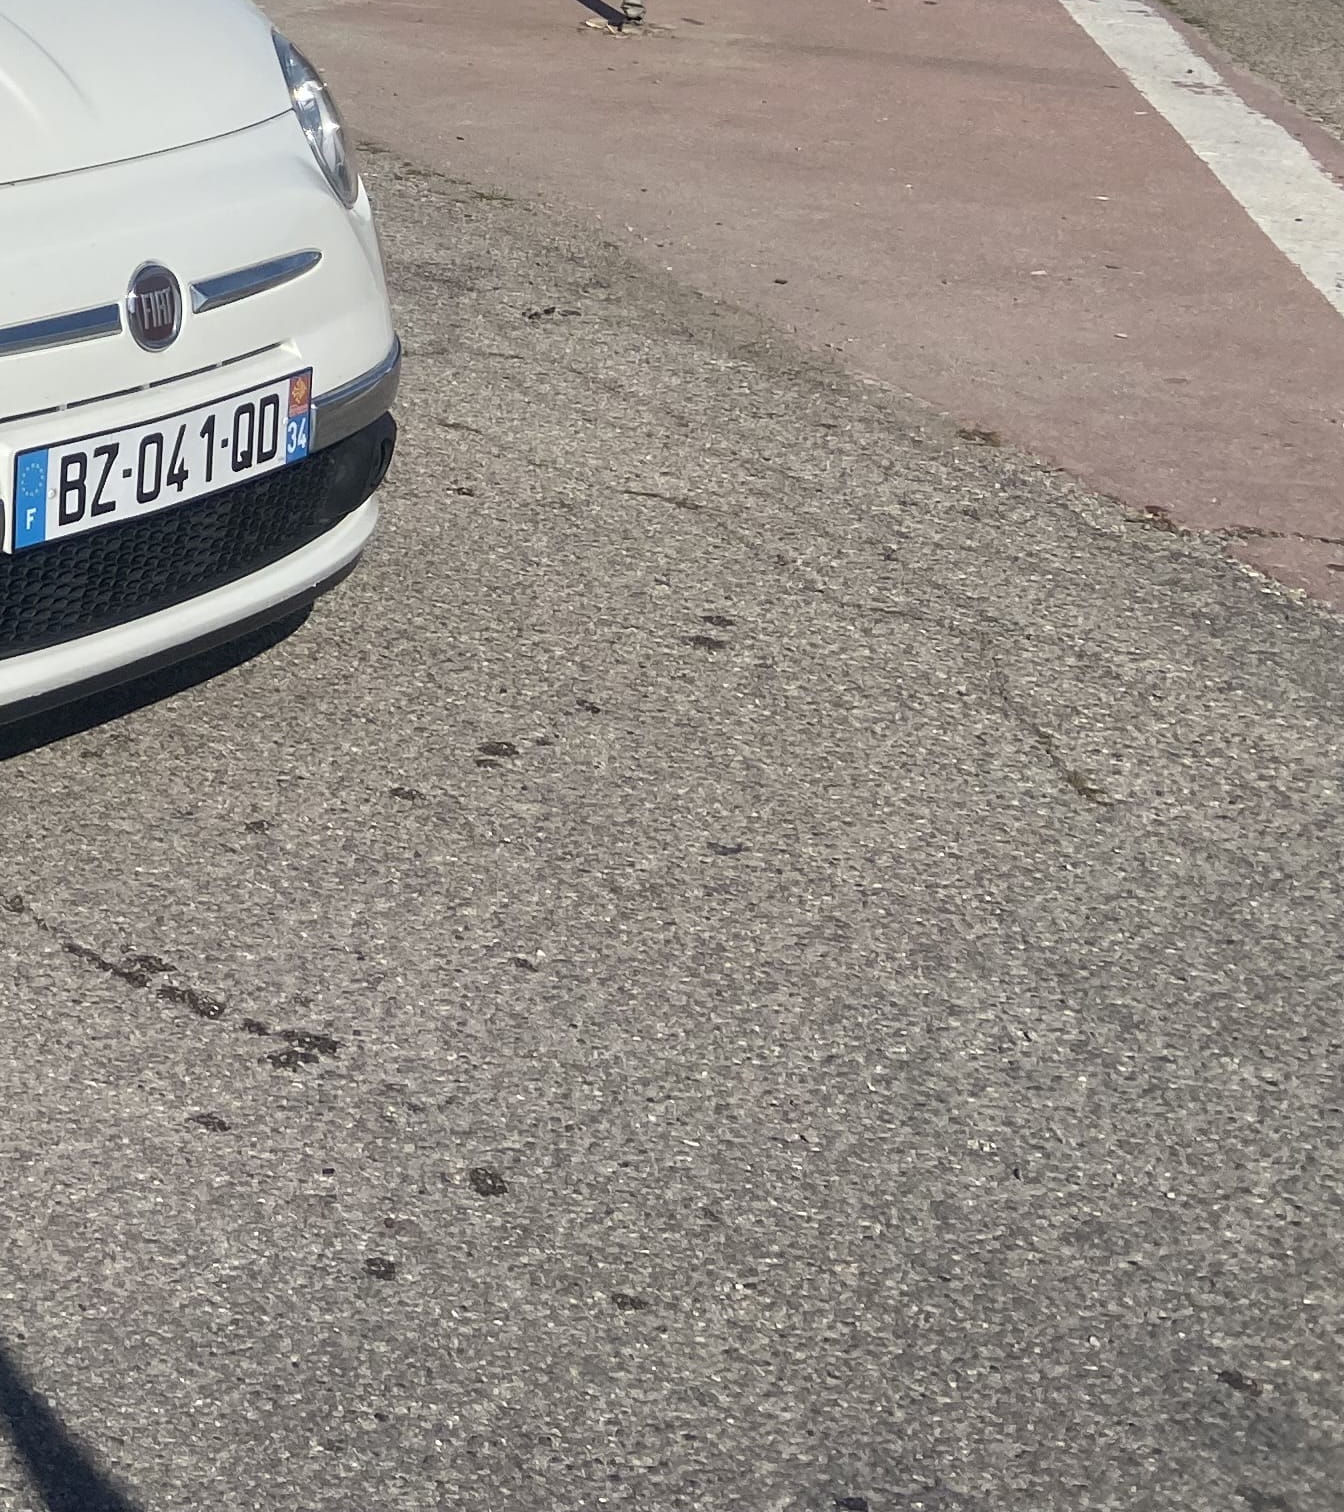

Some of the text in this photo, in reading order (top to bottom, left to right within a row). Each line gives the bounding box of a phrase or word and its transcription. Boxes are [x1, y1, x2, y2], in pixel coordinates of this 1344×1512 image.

[140, 286, 172, 330] FIAT
[287, 420, 308, 454] 34
[58, 393, 280, 526] BZ-041-QD
[25, 507, 37, 531] F
